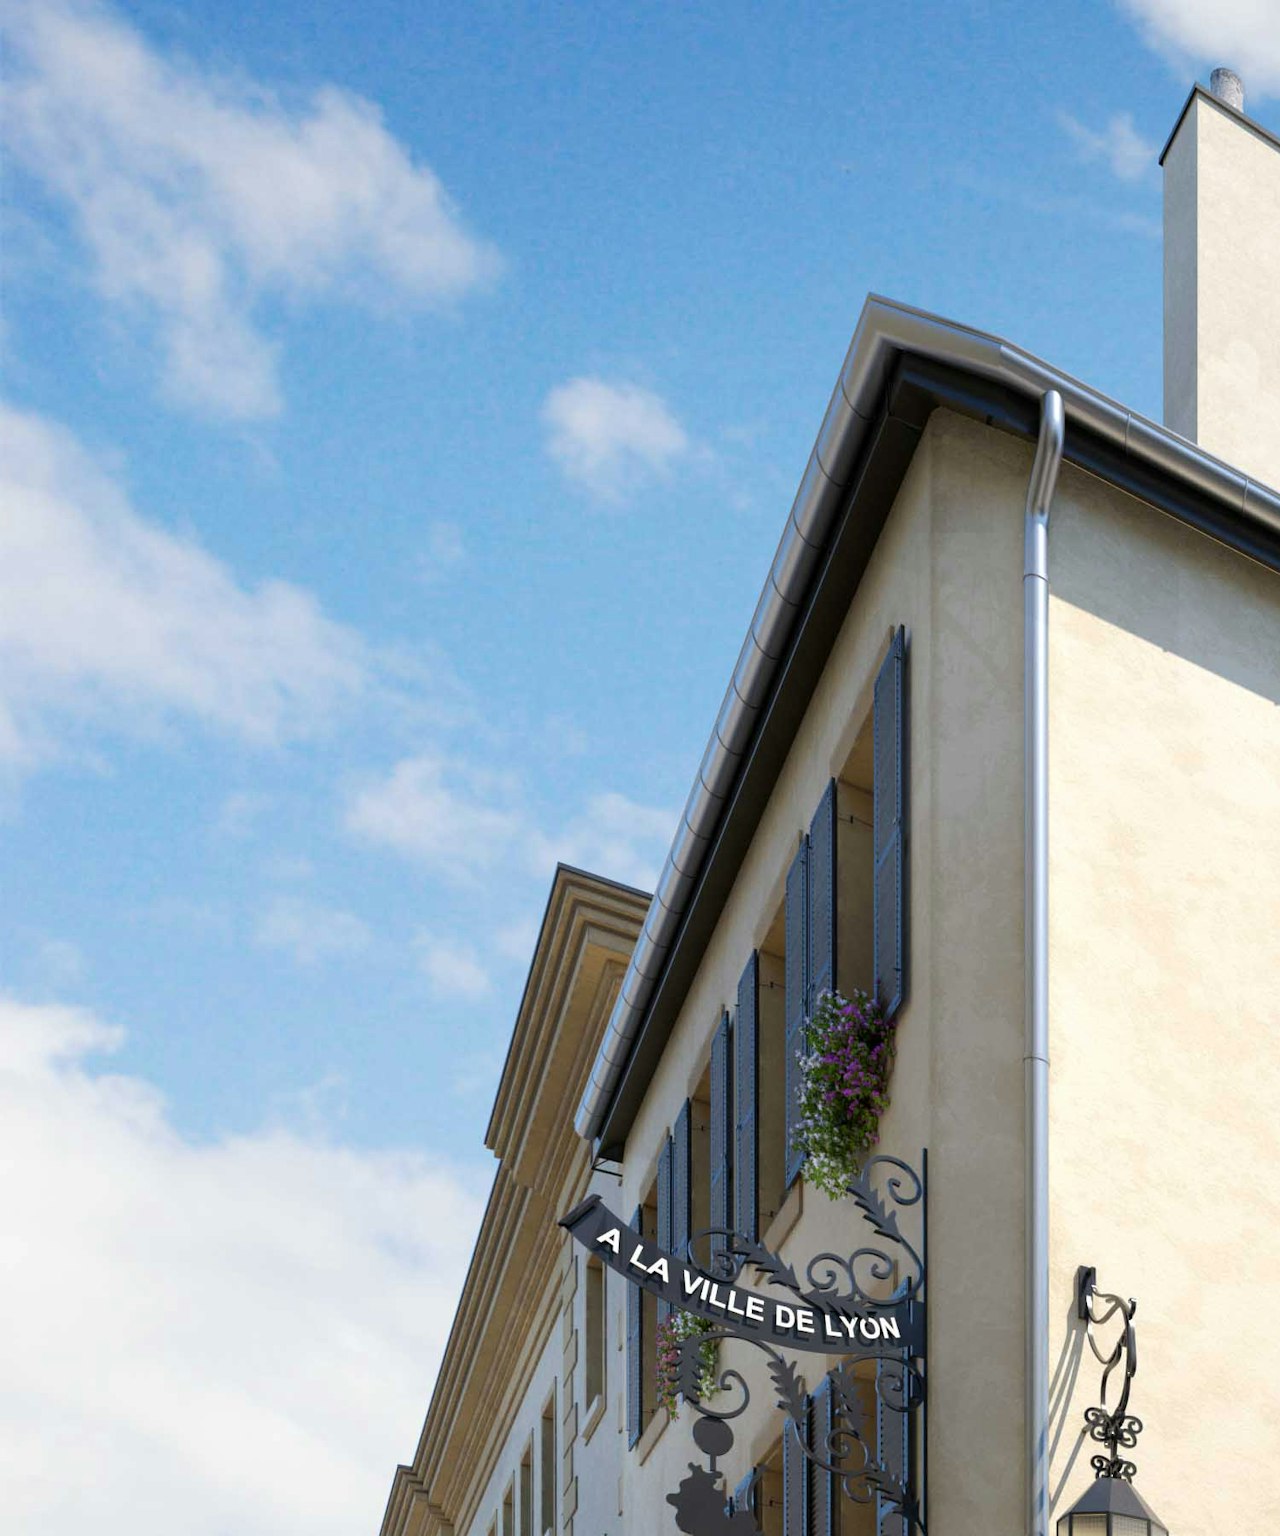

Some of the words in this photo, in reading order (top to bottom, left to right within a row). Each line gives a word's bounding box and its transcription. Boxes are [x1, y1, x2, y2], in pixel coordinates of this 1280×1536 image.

[596, 1228, 621, 1254] A
[629, 1244, 670, 1284] LA
[683, 1269, 765, 1322] VILLE
[775, 1304, 815, 1334] DE
[824, 1313, 901, 1339] LYON
